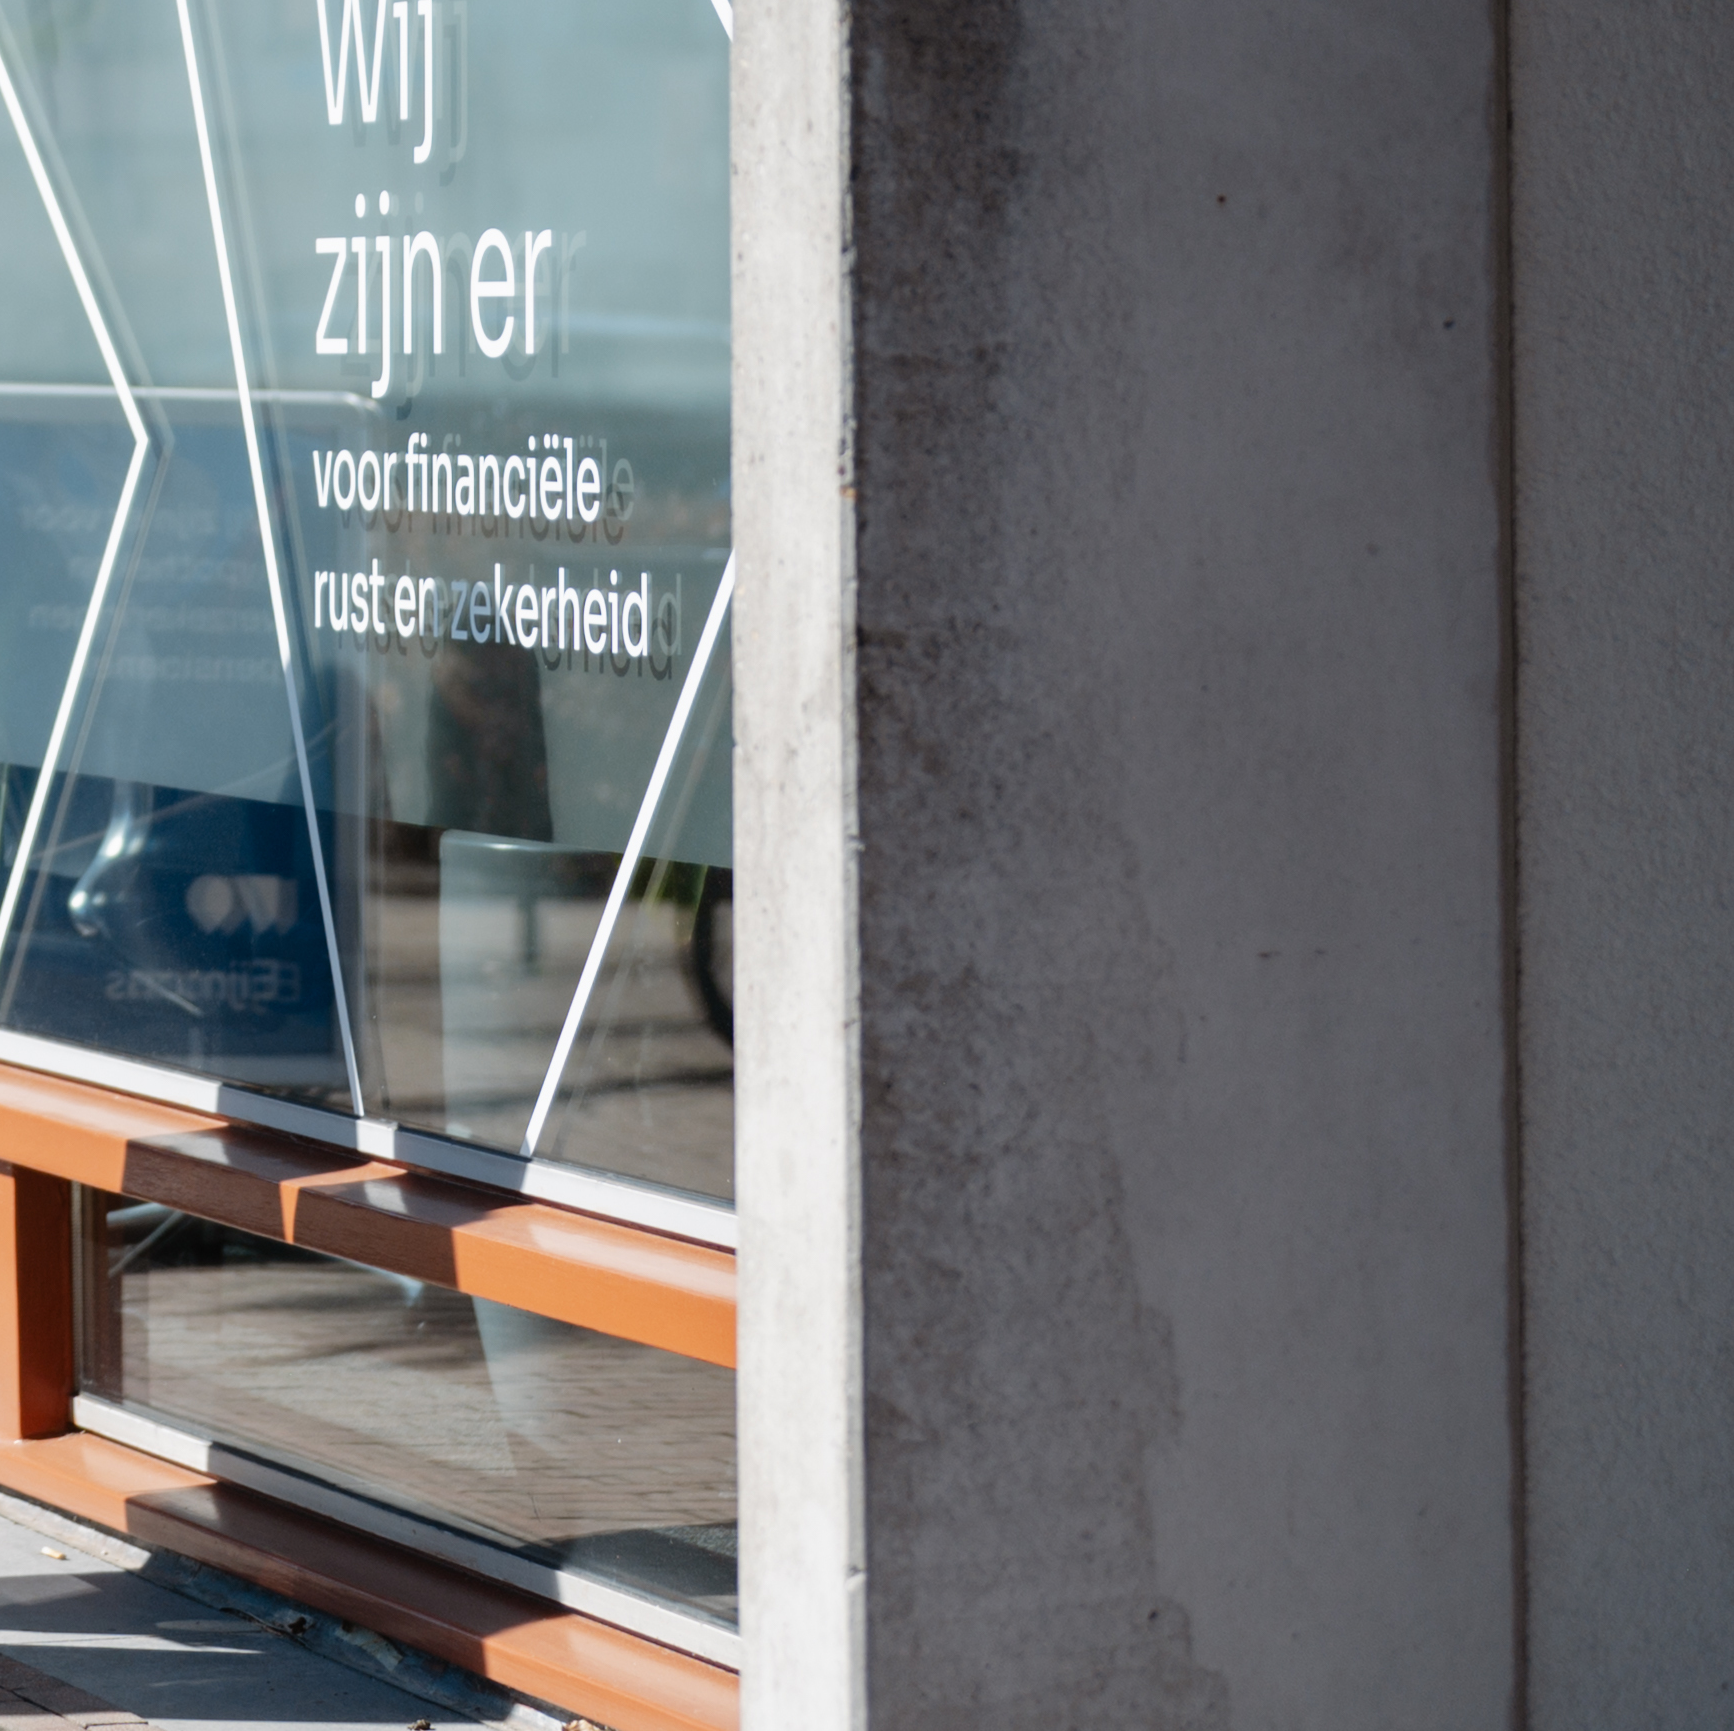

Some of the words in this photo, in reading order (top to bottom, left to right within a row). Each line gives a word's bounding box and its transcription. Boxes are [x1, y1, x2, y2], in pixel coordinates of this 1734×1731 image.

[314, 189, 443, 400] zijn
[469, 226, 553, 360] er
[312, 444, 405, 512] voor
[405, 432, 602, 523] financiële
[313, 557, 386, 635] rust
[393, 574, 437, 639] en
[449, 562, 650, 659] zekerheid
